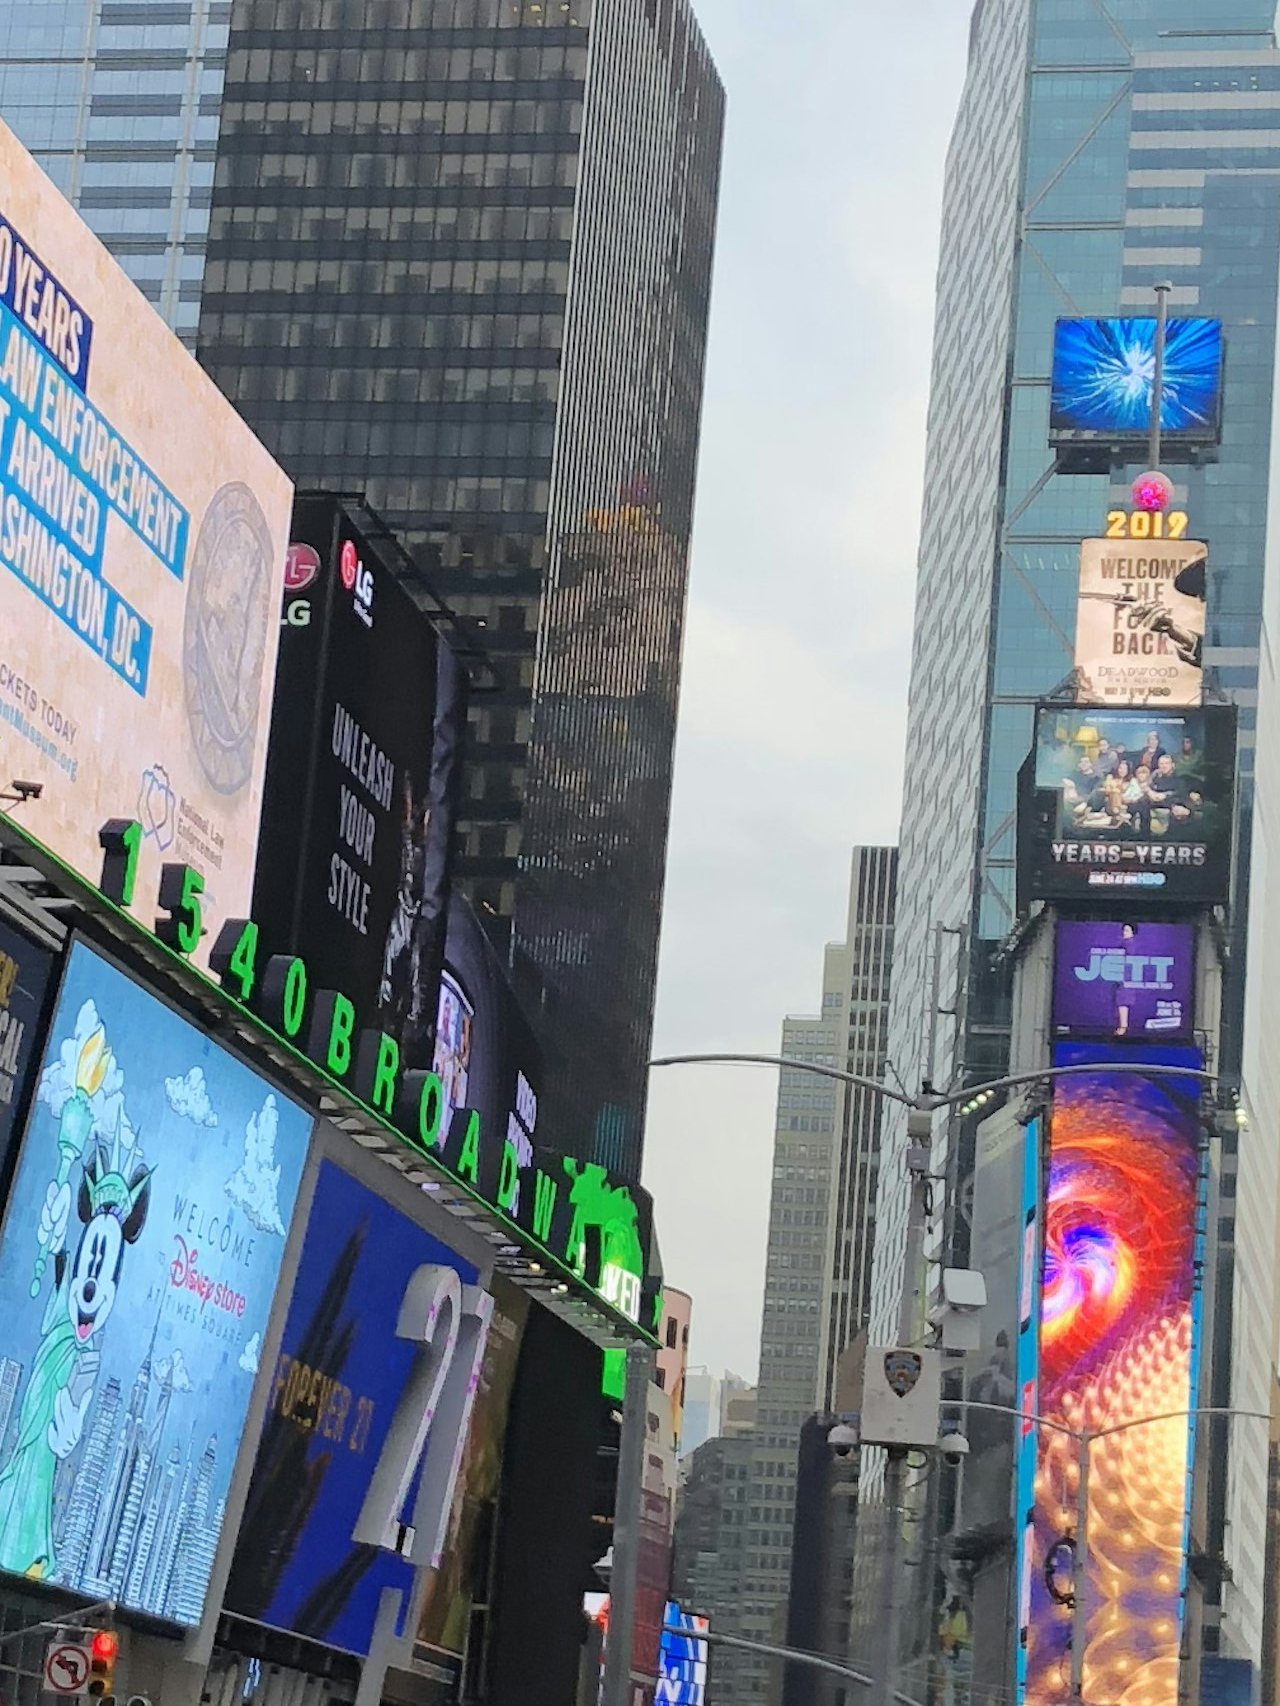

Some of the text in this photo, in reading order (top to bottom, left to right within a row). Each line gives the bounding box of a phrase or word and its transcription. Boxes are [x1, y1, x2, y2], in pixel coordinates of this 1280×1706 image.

[14, 242, 83, 378] YEARS
[8, 416, 99, 558] ARRIVED
[40, 364, 183, 565] ENFORCEMENT
[1106, 511, 1188, 539] 2019
[1101, 558, 1187, 579] WELCOME
[1122, 582, 1164, 601] THE
[1098, 666, 1178, 678] DEADWOOD
[41, 703, 77, 745] TODAY
[332, 702, 394, 811] UNLEASH
[340, 784, 375, 866] YOUR
[1051, 843, 1120, 864] YEARS
[1135, 845, 1206, 866] YEARS
[328, 853, 370, 934] STYLE
[1074, 955, 1174, 981] JETT
[174, 1194, 255, 1267] WELCOME
[214, 1280, 245, 1317] store
[272, 1354, 374, 1455] FOREVER 21
